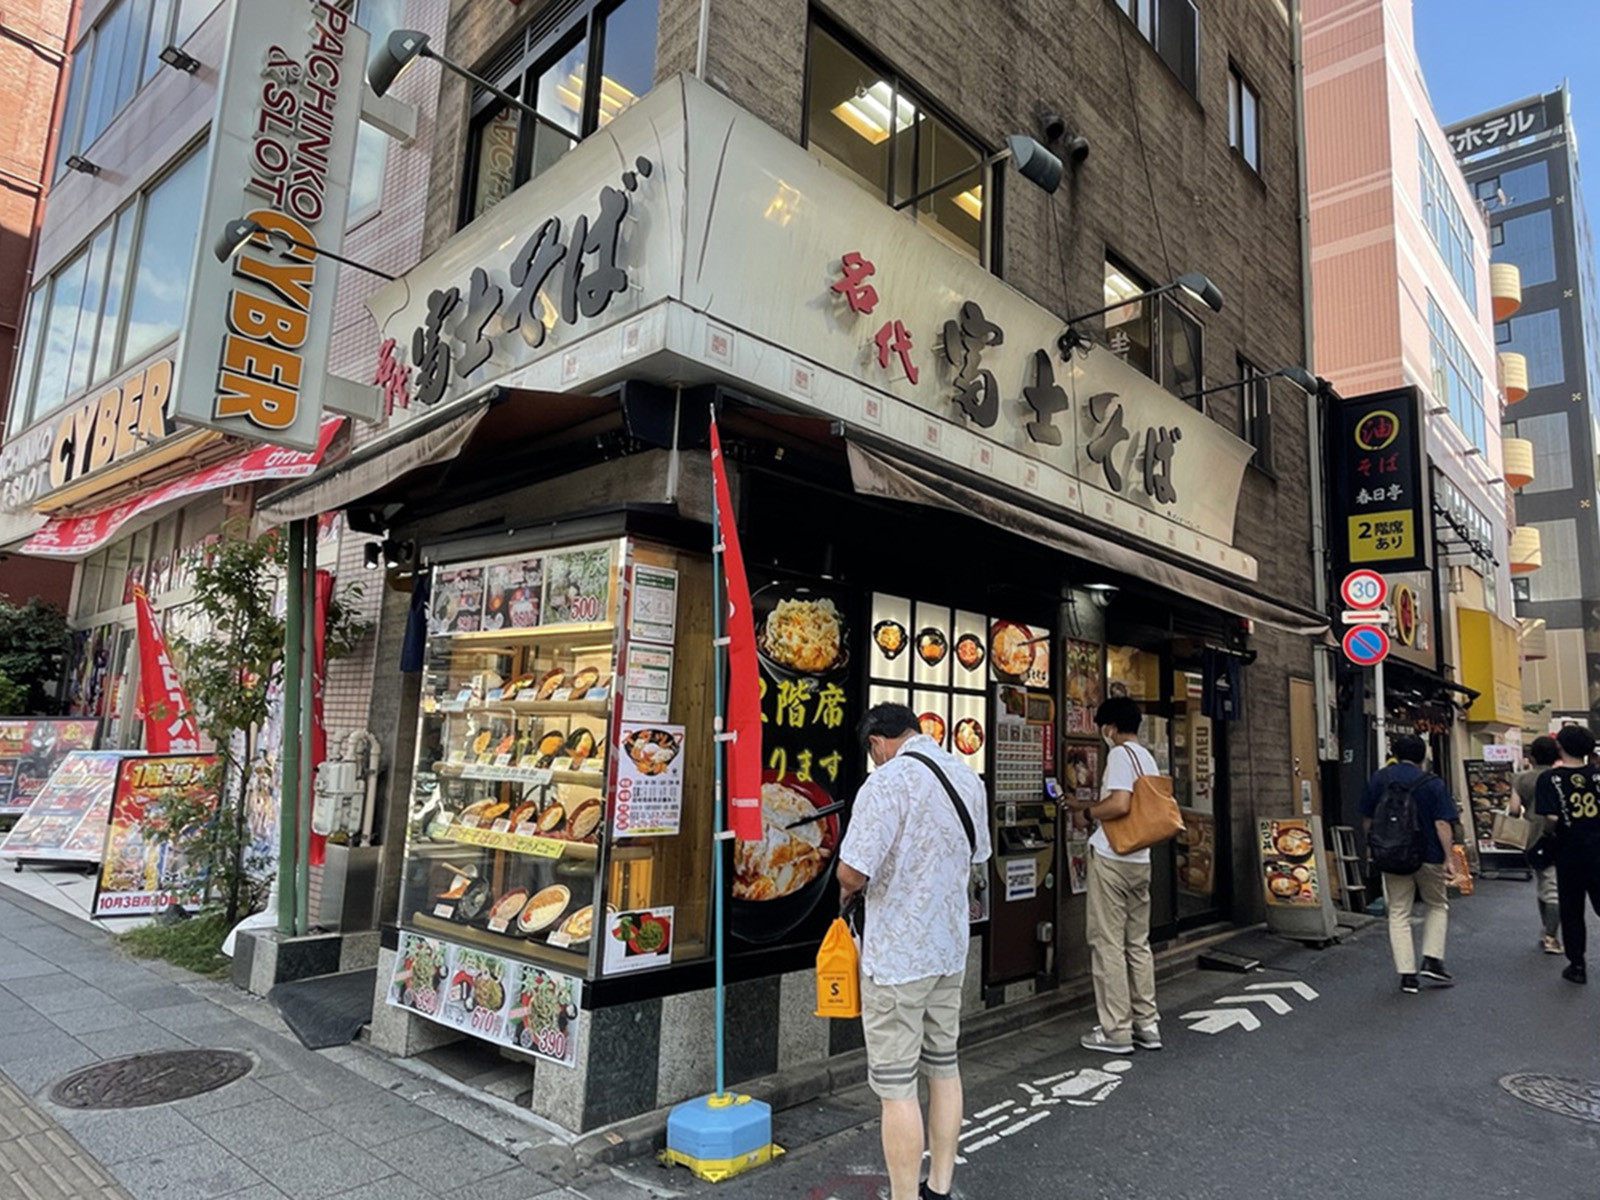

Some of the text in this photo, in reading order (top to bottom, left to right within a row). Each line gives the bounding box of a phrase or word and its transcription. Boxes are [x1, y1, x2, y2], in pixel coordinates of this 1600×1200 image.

[251, 45, 302, 208] & SLOT
[289, 0, 349, 221] PACHINKO
[412, 155, 653, 405] 富士そば
[214, 208, 319, 431] CYBER
[830, 251, 1183, 504] 名代 富士そば
[50, 358, 173, 489] CYBER
[1356, 483, 1404, 505] 春日亭
[1357, 452, 1399, 477] そば
[1375, 536, 1403, 550] あり
[1352, 580, 1378, 600] 30
[1569, 792, 1599, 818] 38
[830, 982, 840, 997] S
